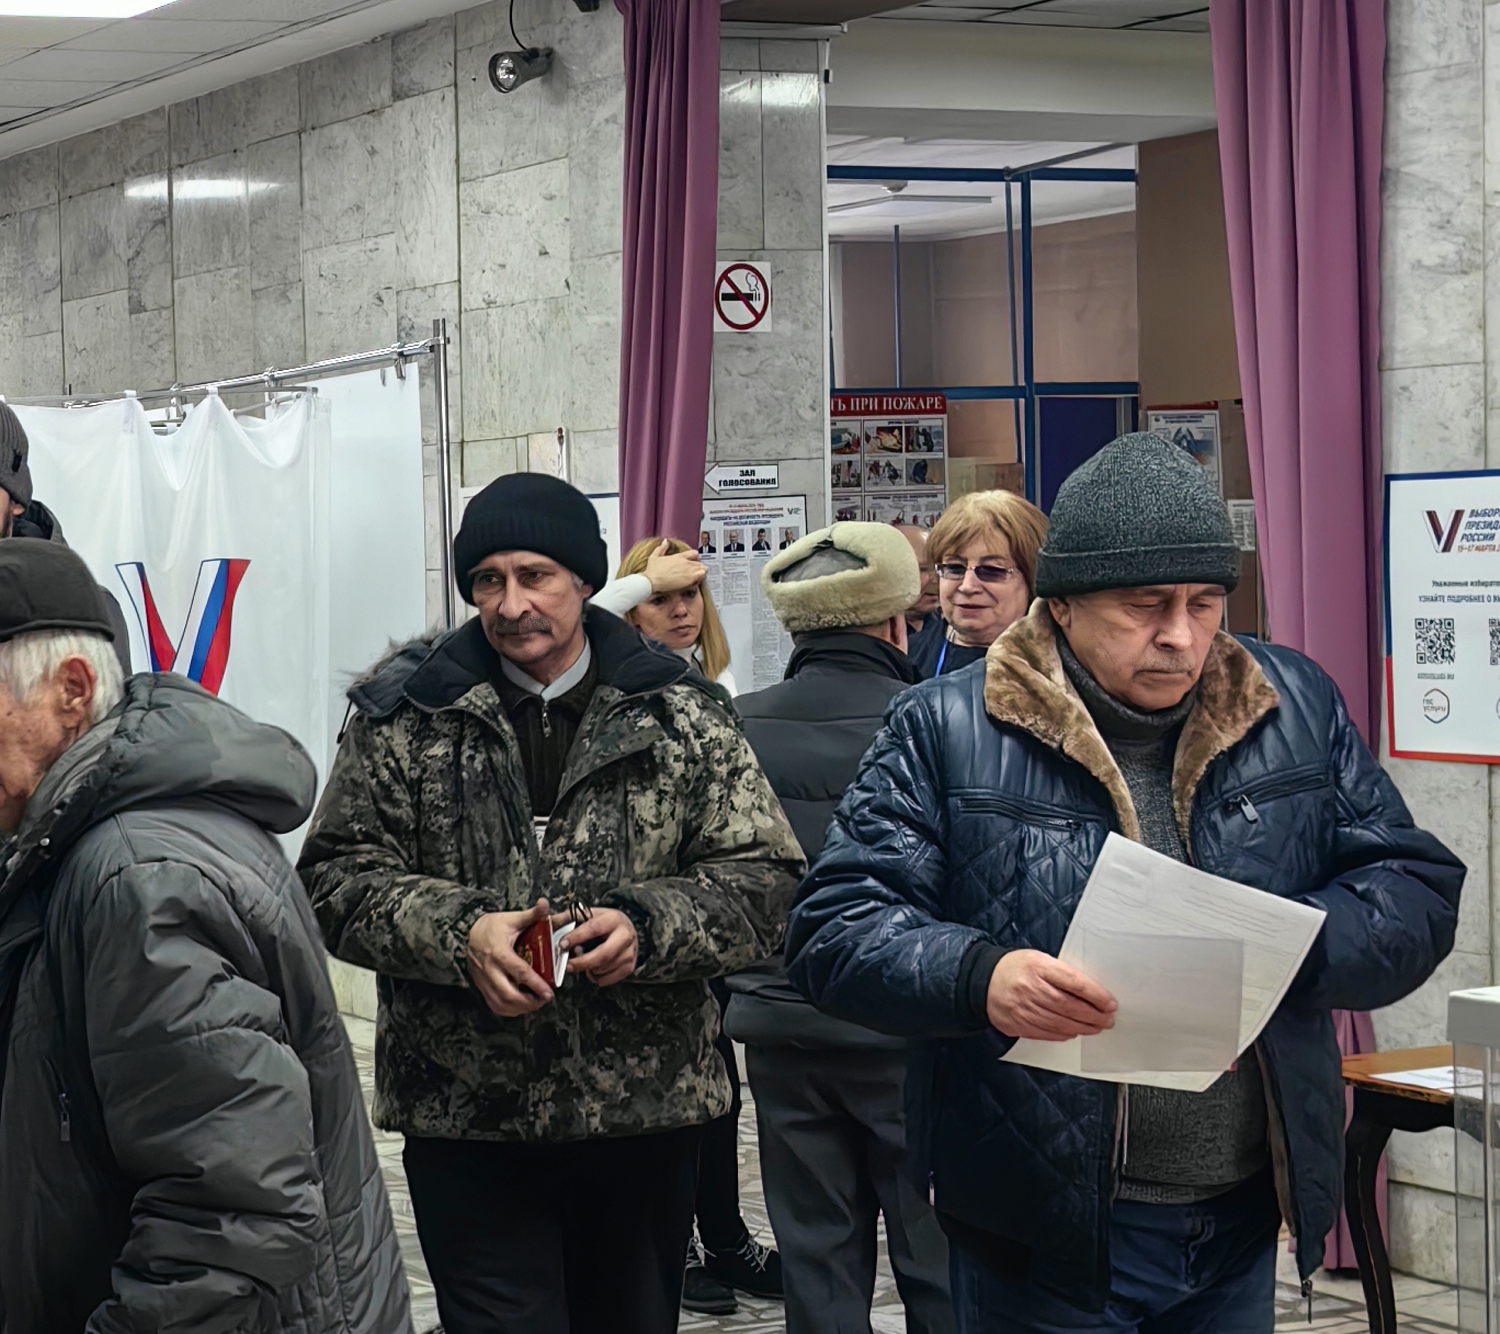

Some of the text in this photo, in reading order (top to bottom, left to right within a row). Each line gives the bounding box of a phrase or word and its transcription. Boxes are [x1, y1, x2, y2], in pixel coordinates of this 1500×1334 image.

[850, 397, 878, 411] ПРИ
[883, 396, 943, 410] ПОЖАРЕ
[739, 469, 756, 477] ЗАЛ
[718, 478, 776, 487] ГОЛОСОВАНИЯ
[1468, 508, 1500, 518] ВЫБОР
[1464, 520, 1500, 530] ПРЕЗИД
[1421, 509, 1466, 554] V
[1460, 533, 1496, 542] РОССИИ
